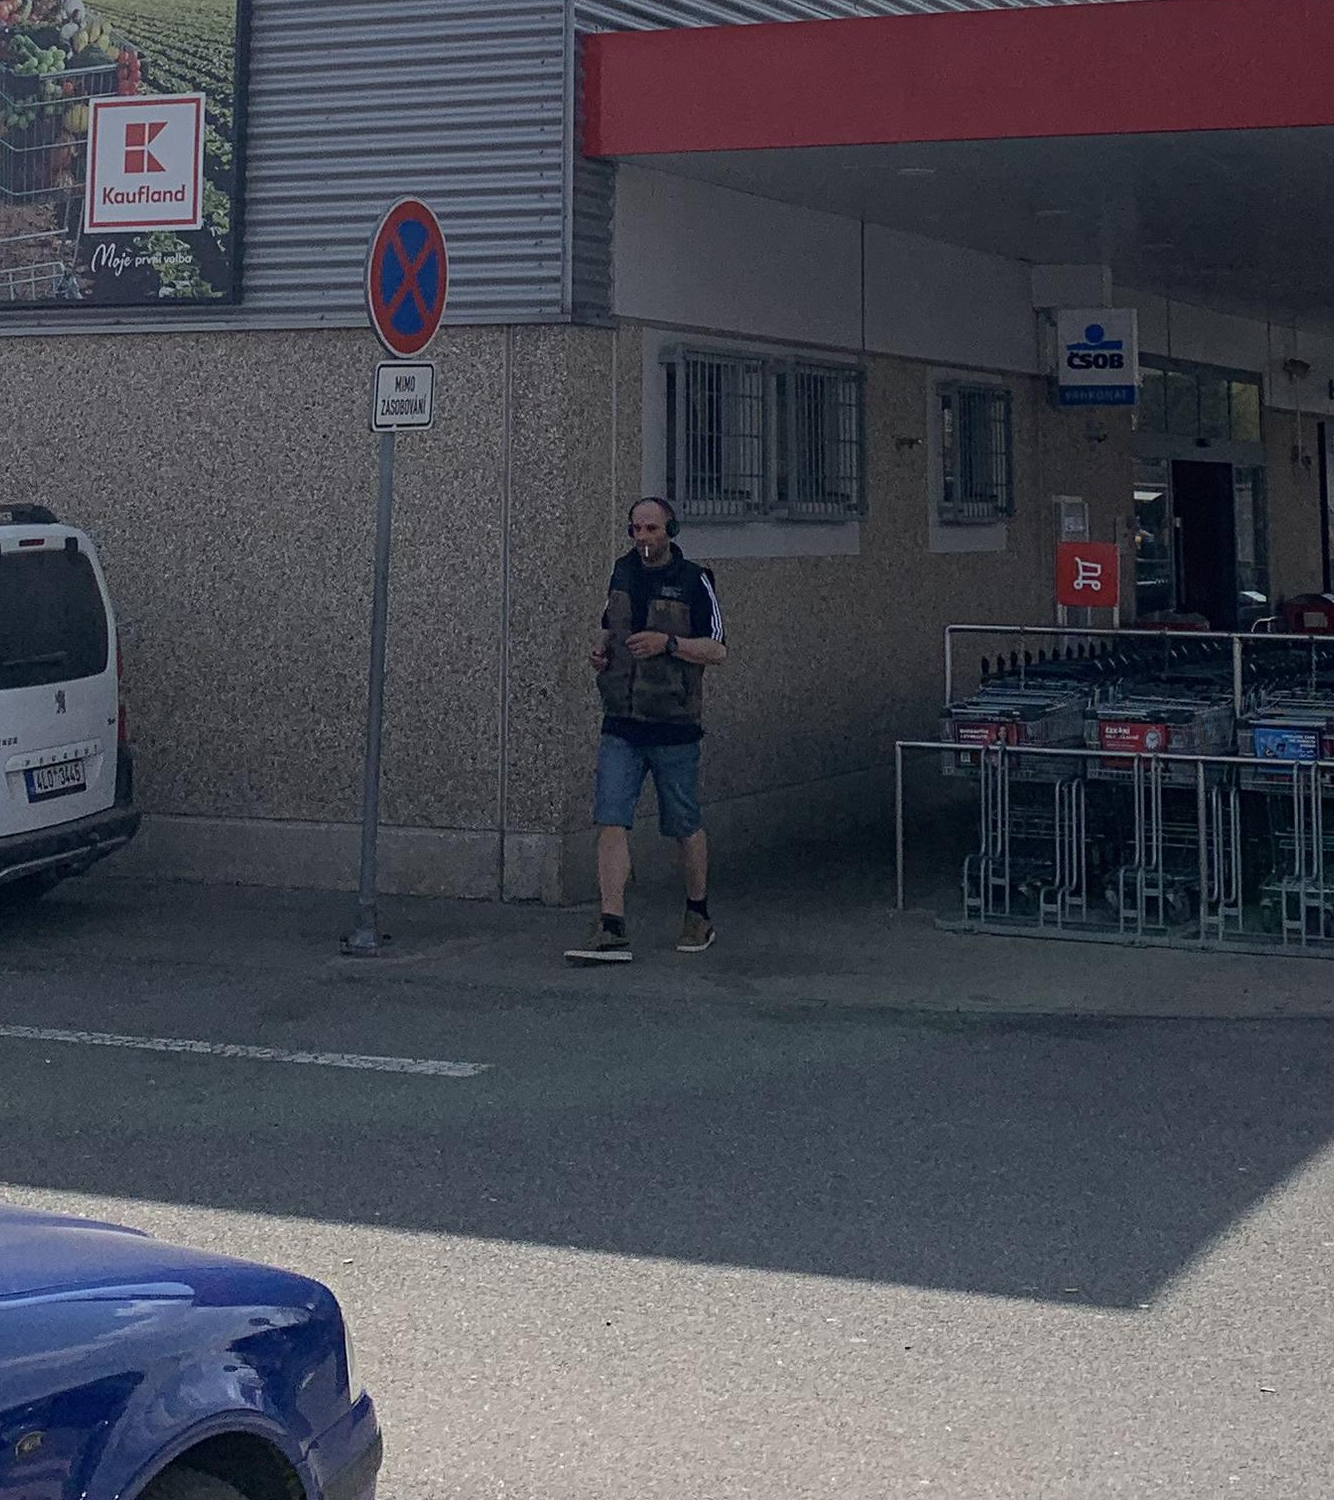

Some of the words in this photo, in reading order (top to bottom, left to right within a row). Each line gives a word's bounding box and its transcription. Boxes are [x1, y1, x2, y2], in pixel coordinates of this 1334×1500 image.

[102, 184, 186, 205] Kaufland
[91, 243, 133, 276] Moje
[164, 252, 193, 264] volba
[1067, 351, 1124, 370] ČSOB
[394, 375, 416, 393] MIMO
[381, 394, 427, 416] ZÁSOBOVÁNÍ
